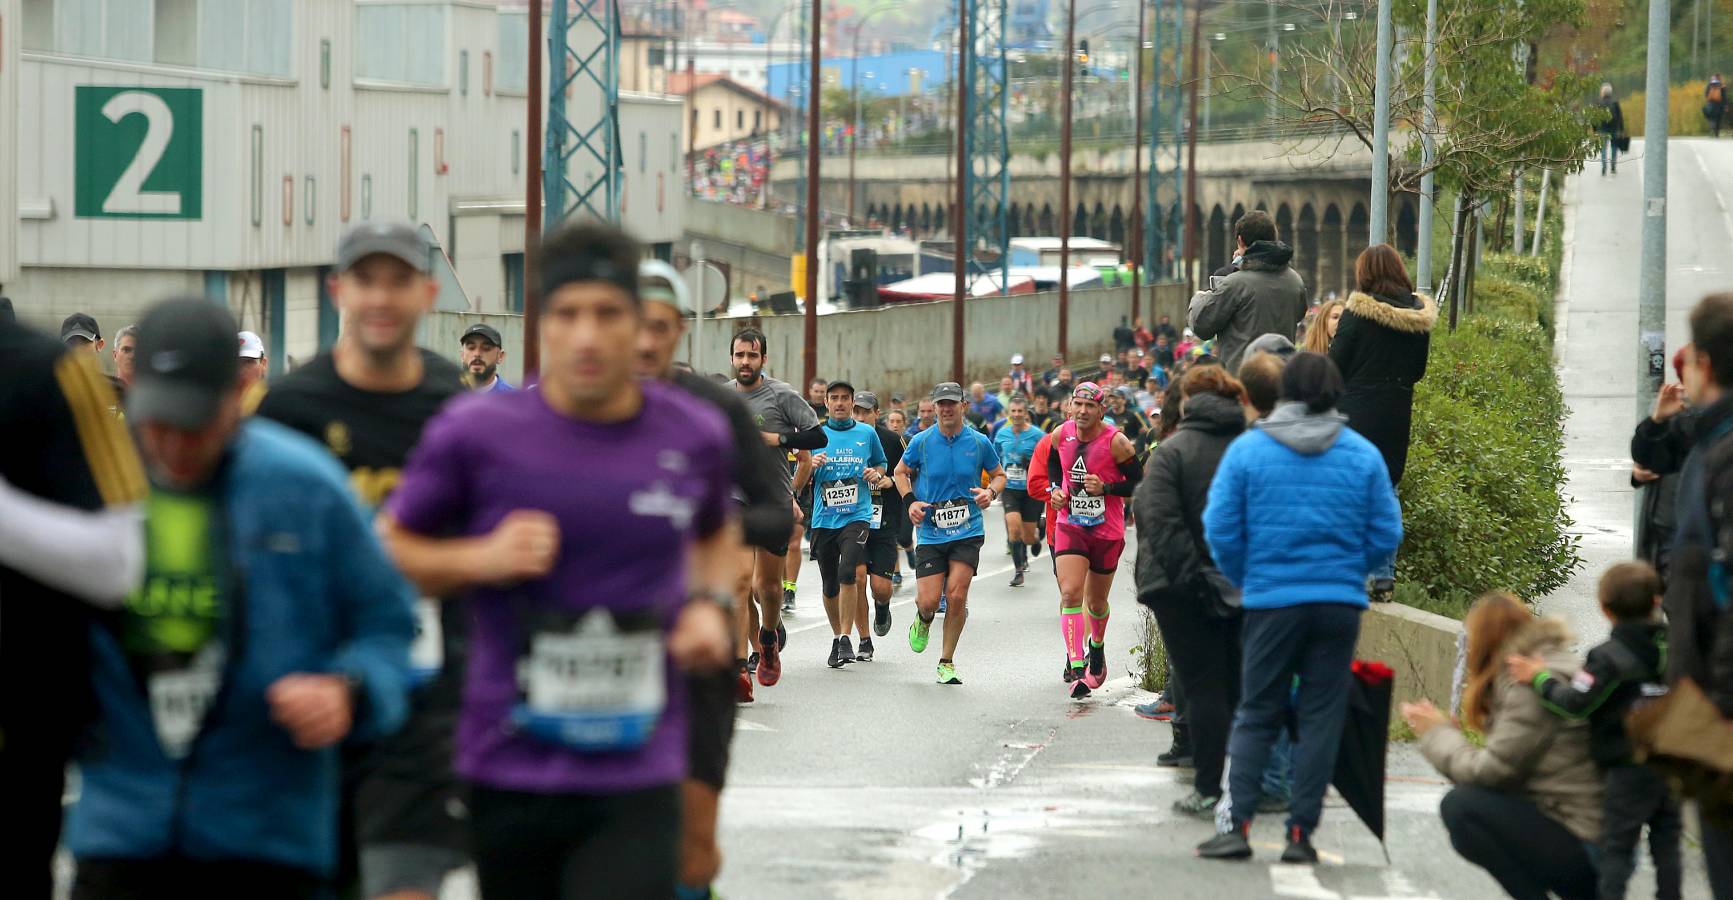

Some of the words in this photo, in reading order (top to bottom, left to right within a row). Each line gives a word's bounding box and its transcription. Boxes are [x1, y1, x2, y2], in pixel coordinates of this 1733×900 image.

[101, 90, 182, 214] 2
[826, 487, 856, 500] 12537
[1072, 499, 1101, 510] 12243
[935, 508, 966, 522] 11877
